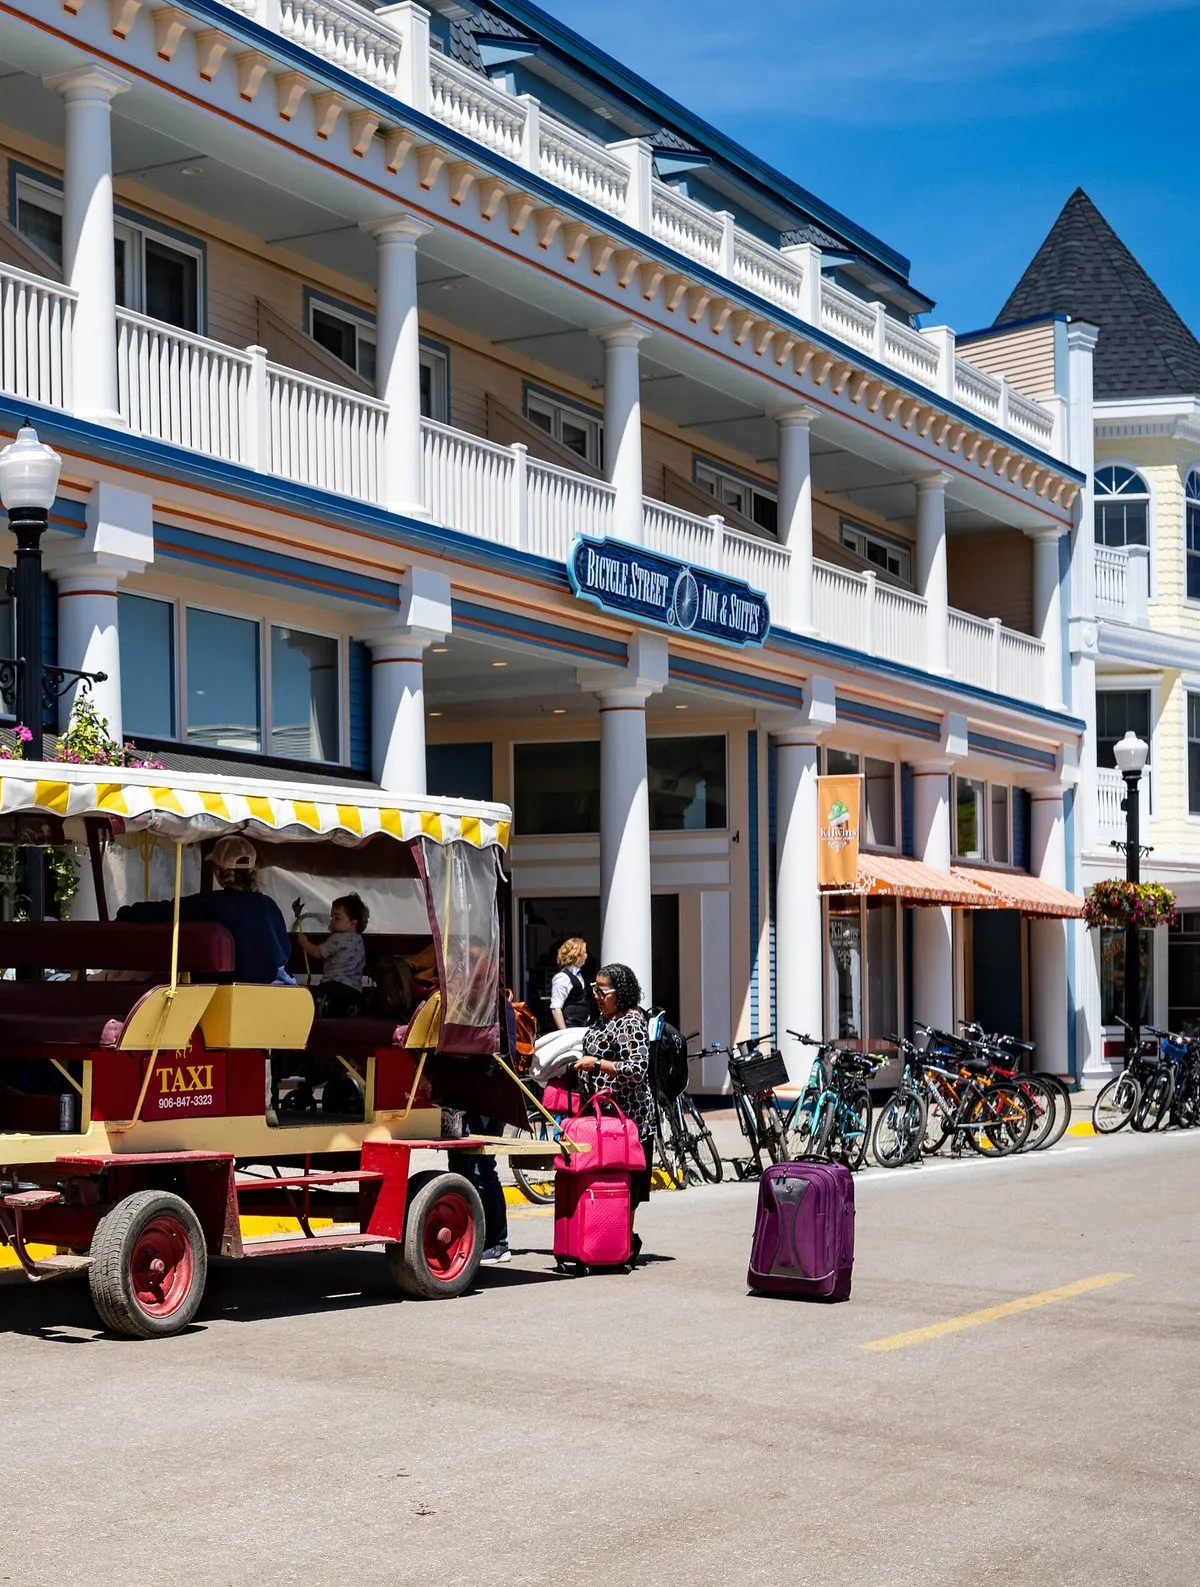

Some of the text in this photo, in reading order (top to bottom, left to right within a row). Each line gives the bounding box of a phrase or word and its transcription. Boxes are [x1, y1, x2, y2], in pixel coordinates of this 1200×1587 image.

[719, 594, 728, 625] &
[156, 1065, 214, 1093] TAXI
[158, 1094, 213, 1109] 906-847-3323
